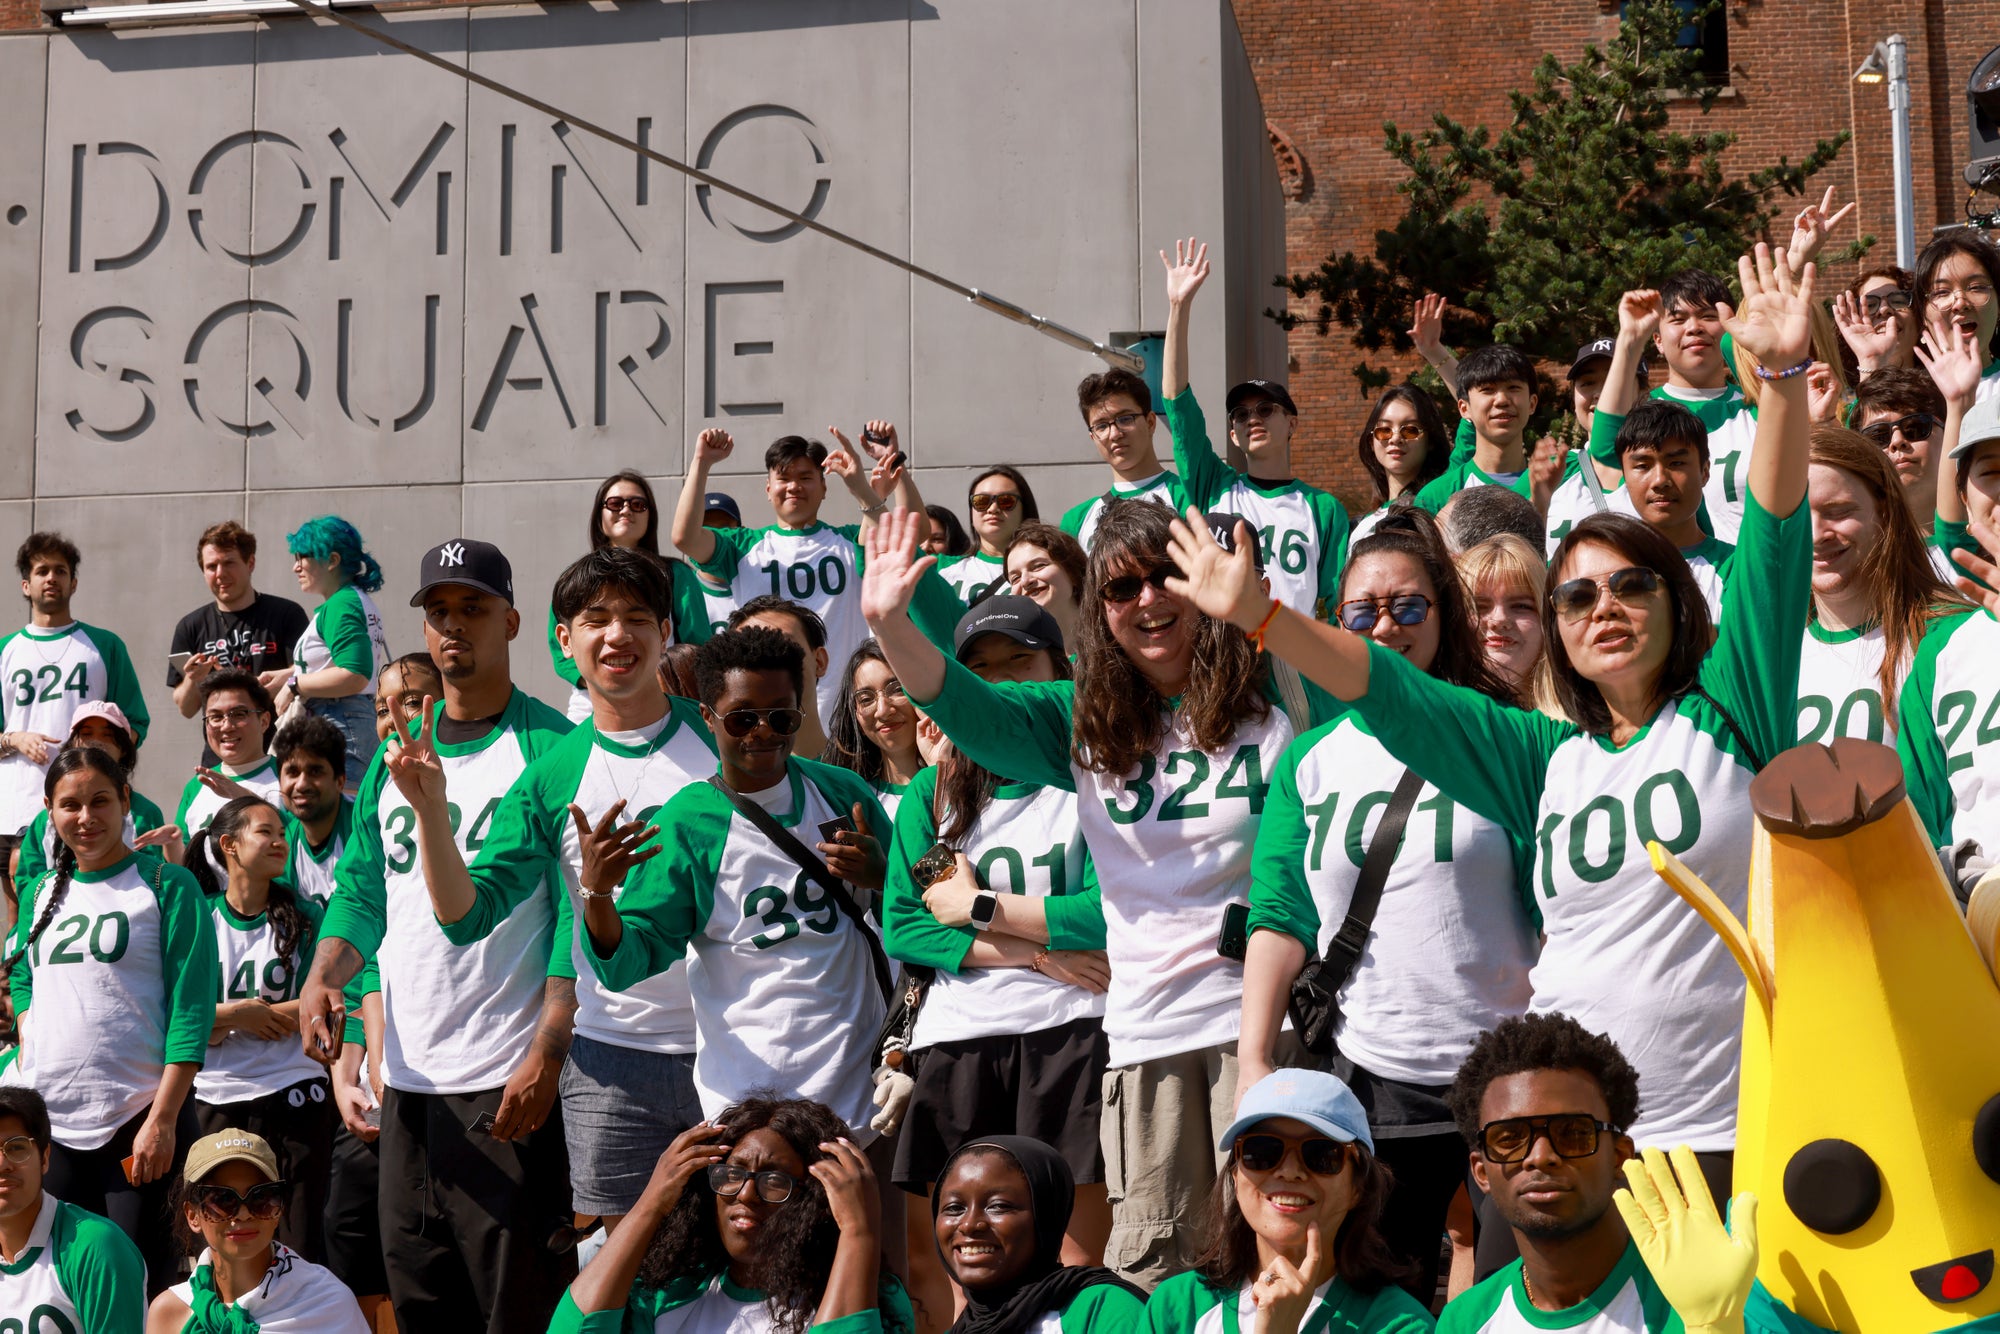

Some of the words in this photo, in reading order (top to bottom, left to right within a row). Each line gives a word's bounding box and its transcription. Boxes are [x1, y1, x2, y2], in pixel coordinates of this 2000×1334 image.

[69, 104, 832, 273] DOMINO
[65, 281, 784, 441] SQUARE
[440, 542, 465, 567] NY
[761, 555, 846, 600] 100
[11, 662, 89, 707] 324
[1104, 744, 1270, 825] 324
[1305, 790, 1455, 871] 101
[1536, 768, 1702, 900] 100
[957, 842, 1066, 896] 01
[215, 1138, 254, 1150] VUORI
